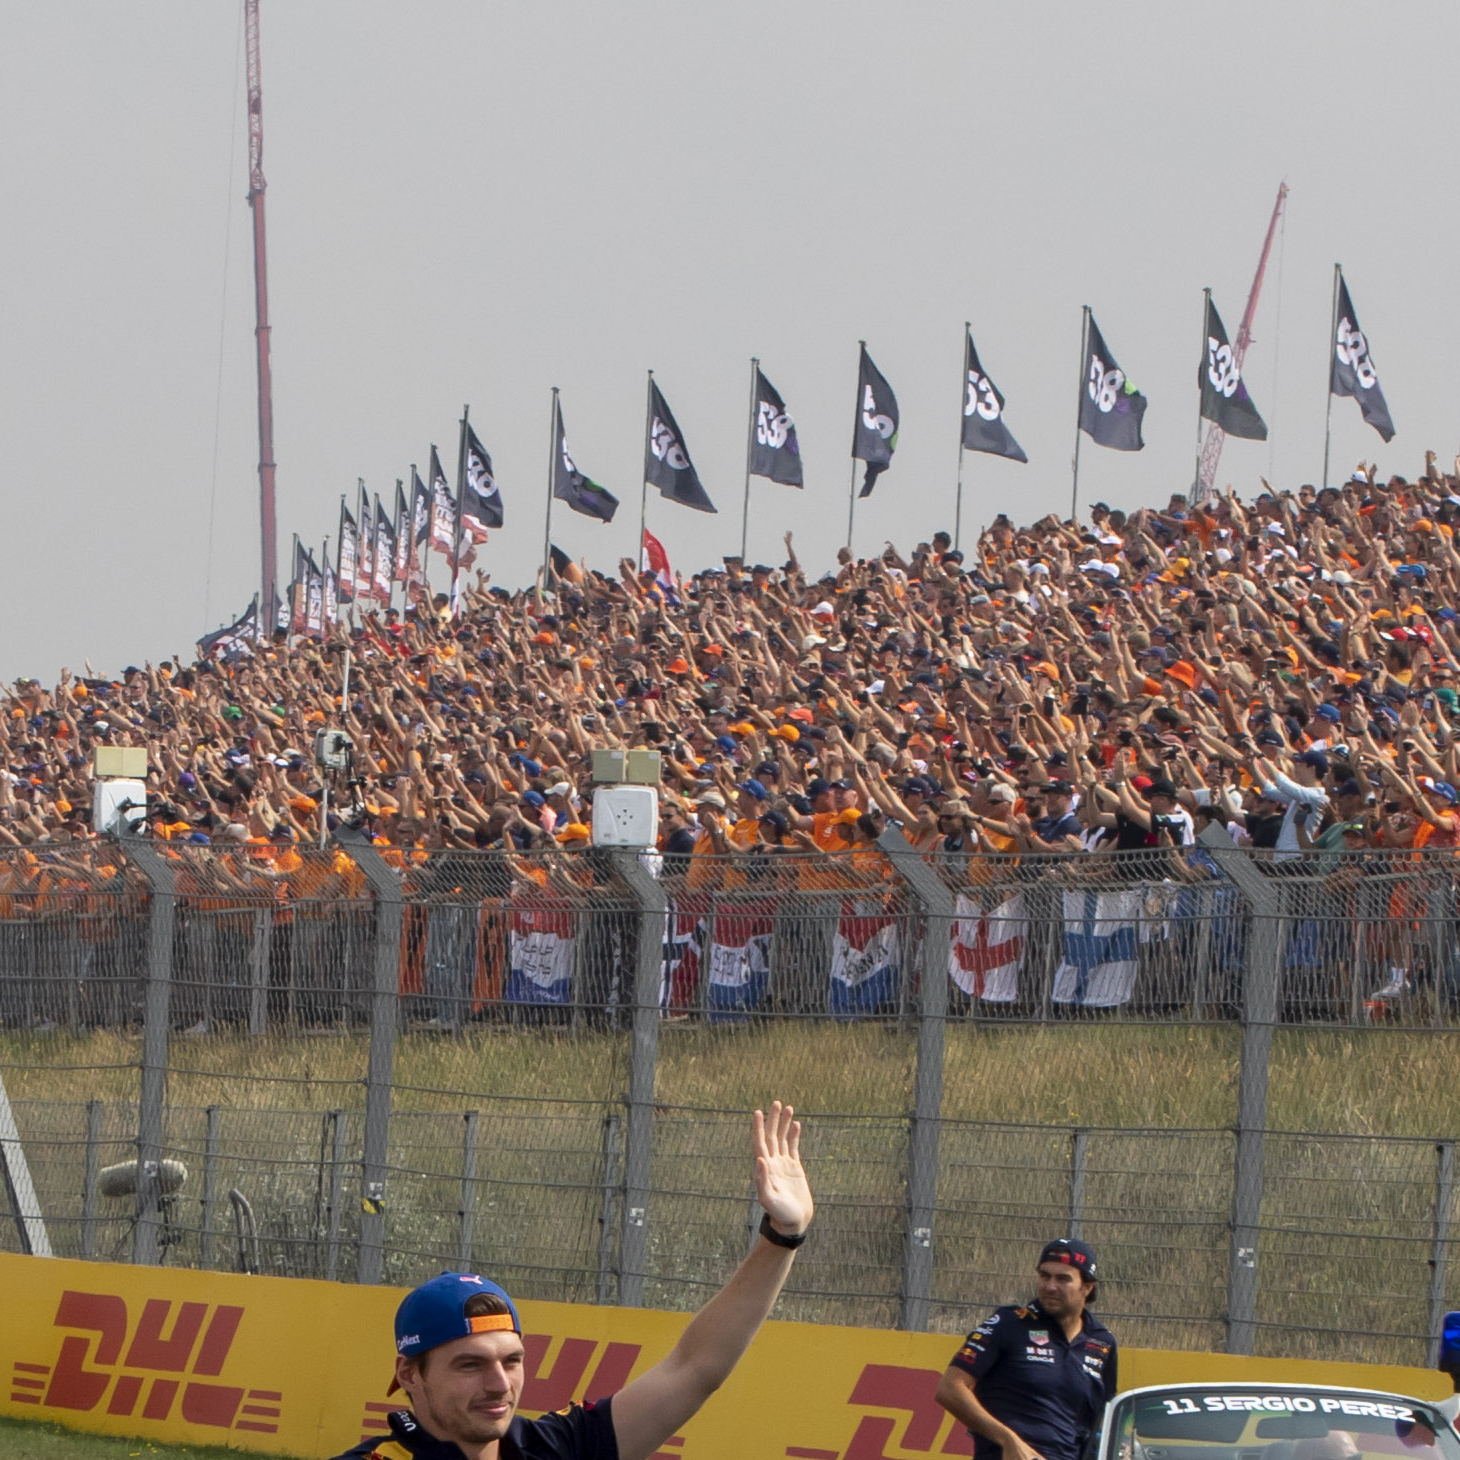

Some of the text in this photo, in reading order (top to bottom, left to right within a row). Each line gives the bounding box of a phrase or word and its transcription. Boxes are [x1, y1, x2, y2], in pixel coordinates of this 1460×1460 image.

[44, 1290, 245, 1428] DHL
[1163, 1396, 1416, 1423] 11 SERGIO PEREZ
